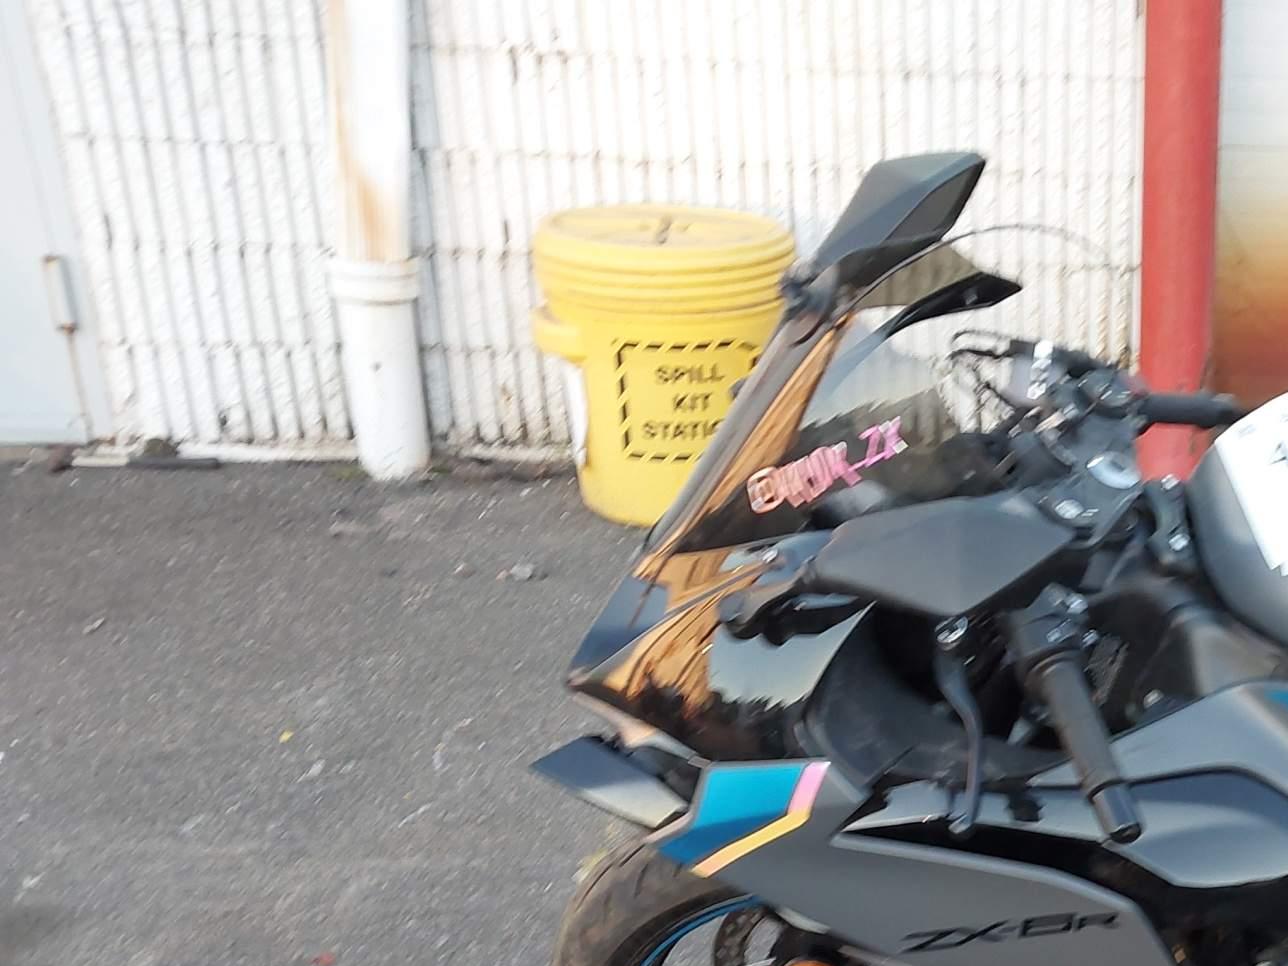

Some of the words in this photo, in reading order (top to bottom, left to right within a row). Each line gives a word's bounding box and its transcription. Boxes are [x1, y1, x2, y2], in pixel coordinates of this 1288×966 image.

[656, 364, 724, 383] SPILL
[673, 393, 711, 410] KIT
[642, 418, 726, 439] STATIO
